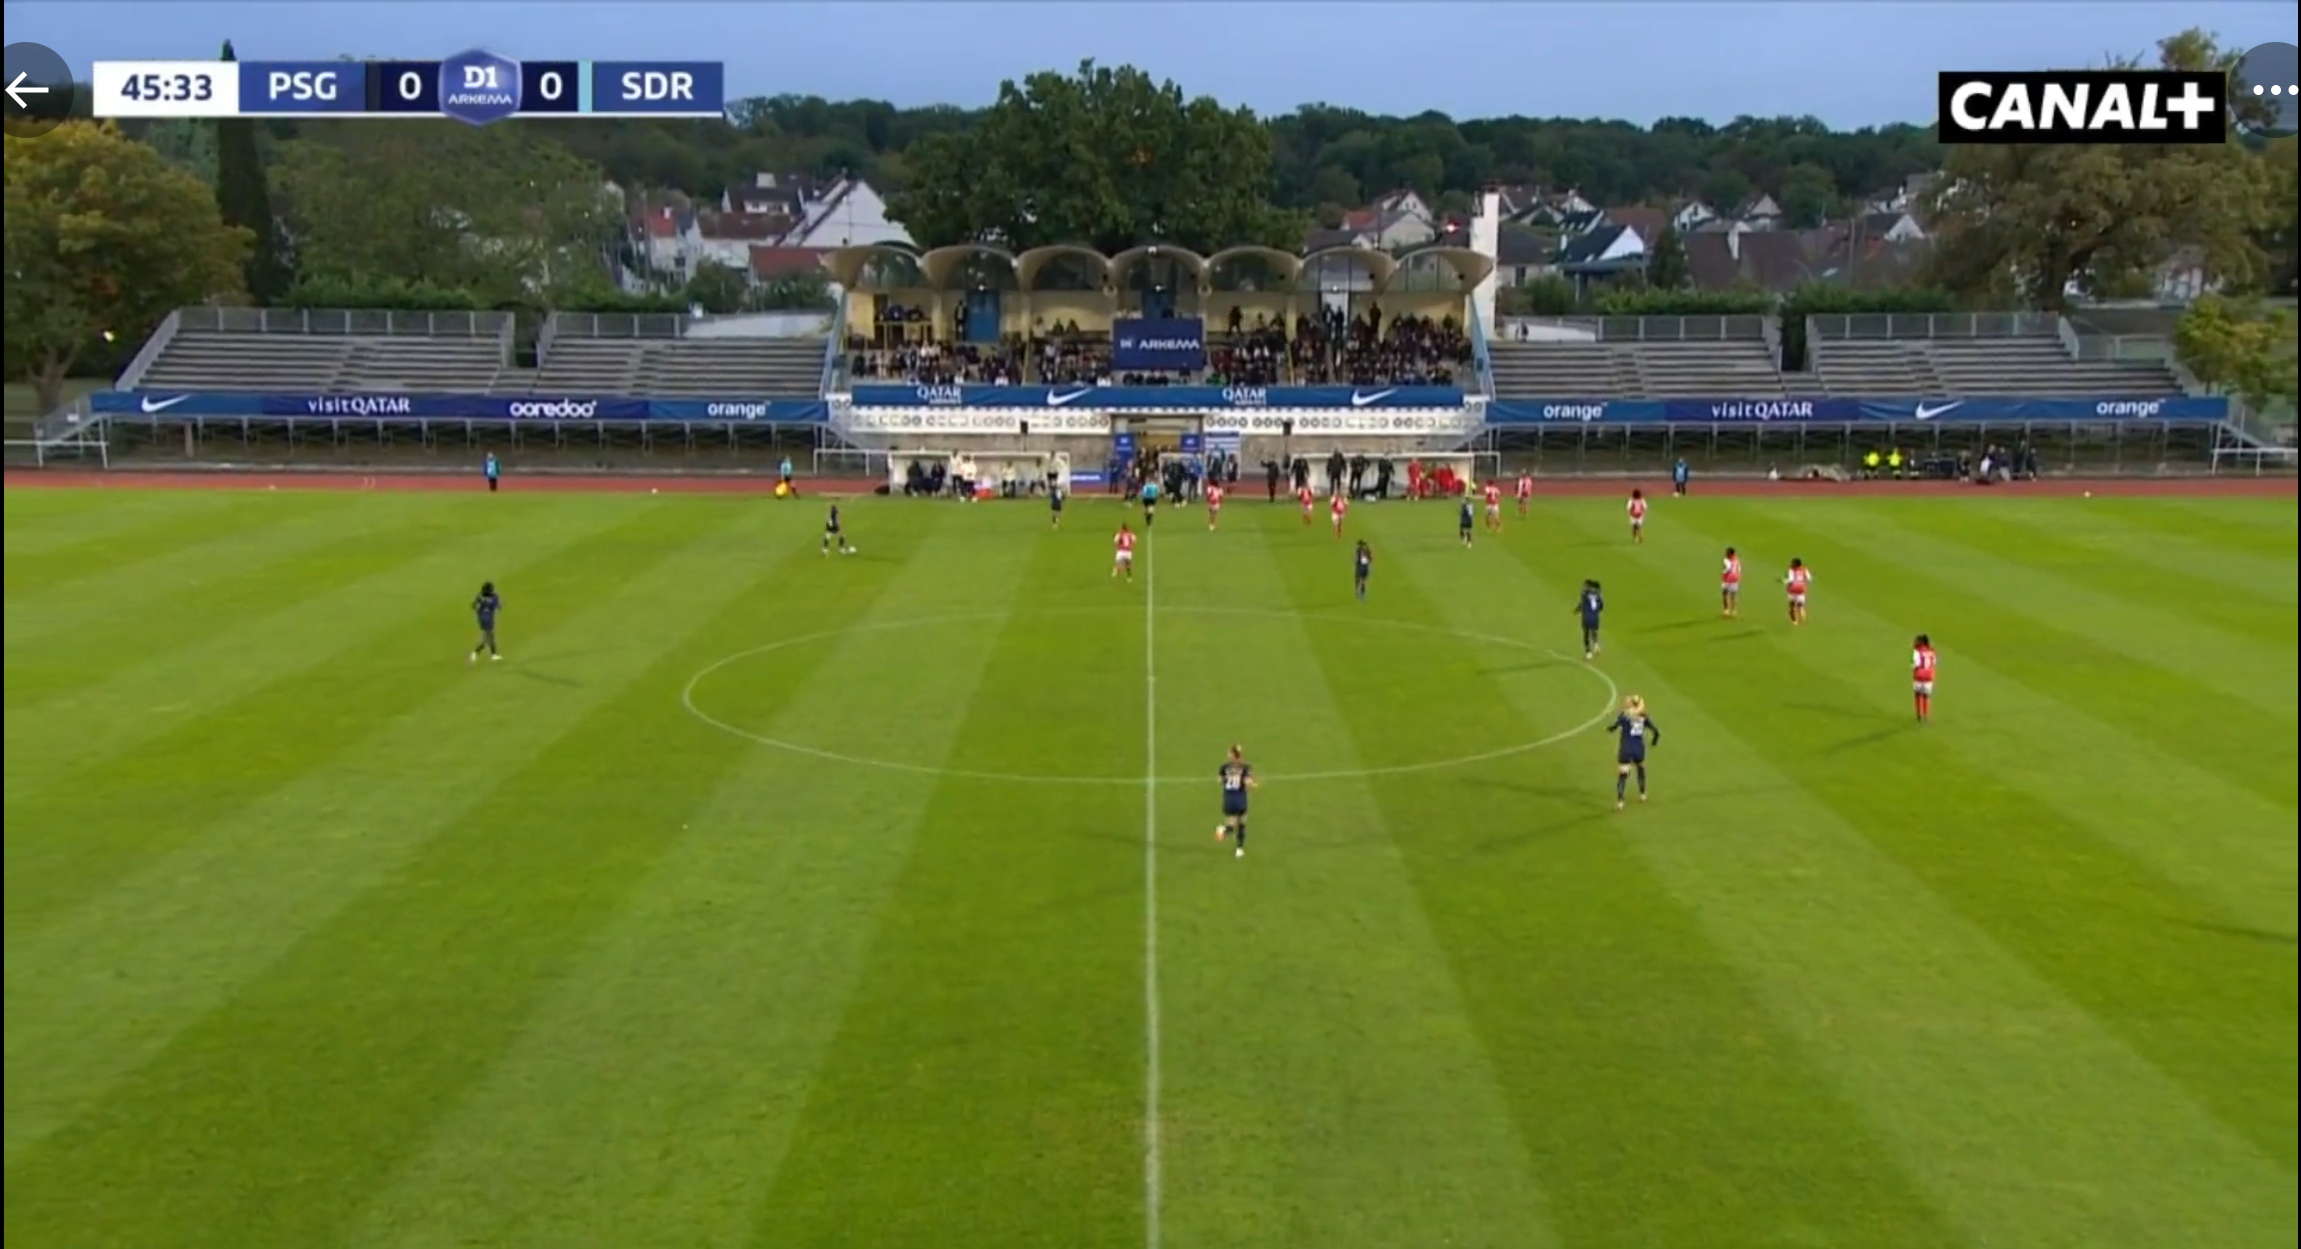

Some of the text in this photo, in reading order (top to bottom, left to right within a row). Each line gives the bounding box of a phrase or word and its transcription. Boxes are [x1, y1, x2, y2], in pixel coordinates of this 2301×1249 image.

[1139, 338, 1200, 350] ARKEMA
[917, 386, 962, 399] QATAR
[1222, 388, 1267, 401] QATAR
[509, 399, 594, 418] ooredoo
[707, 403, 767, 419] orange
[1543, 404, 1603, 421] orange
[2096, 400, 2160, 418] orange
